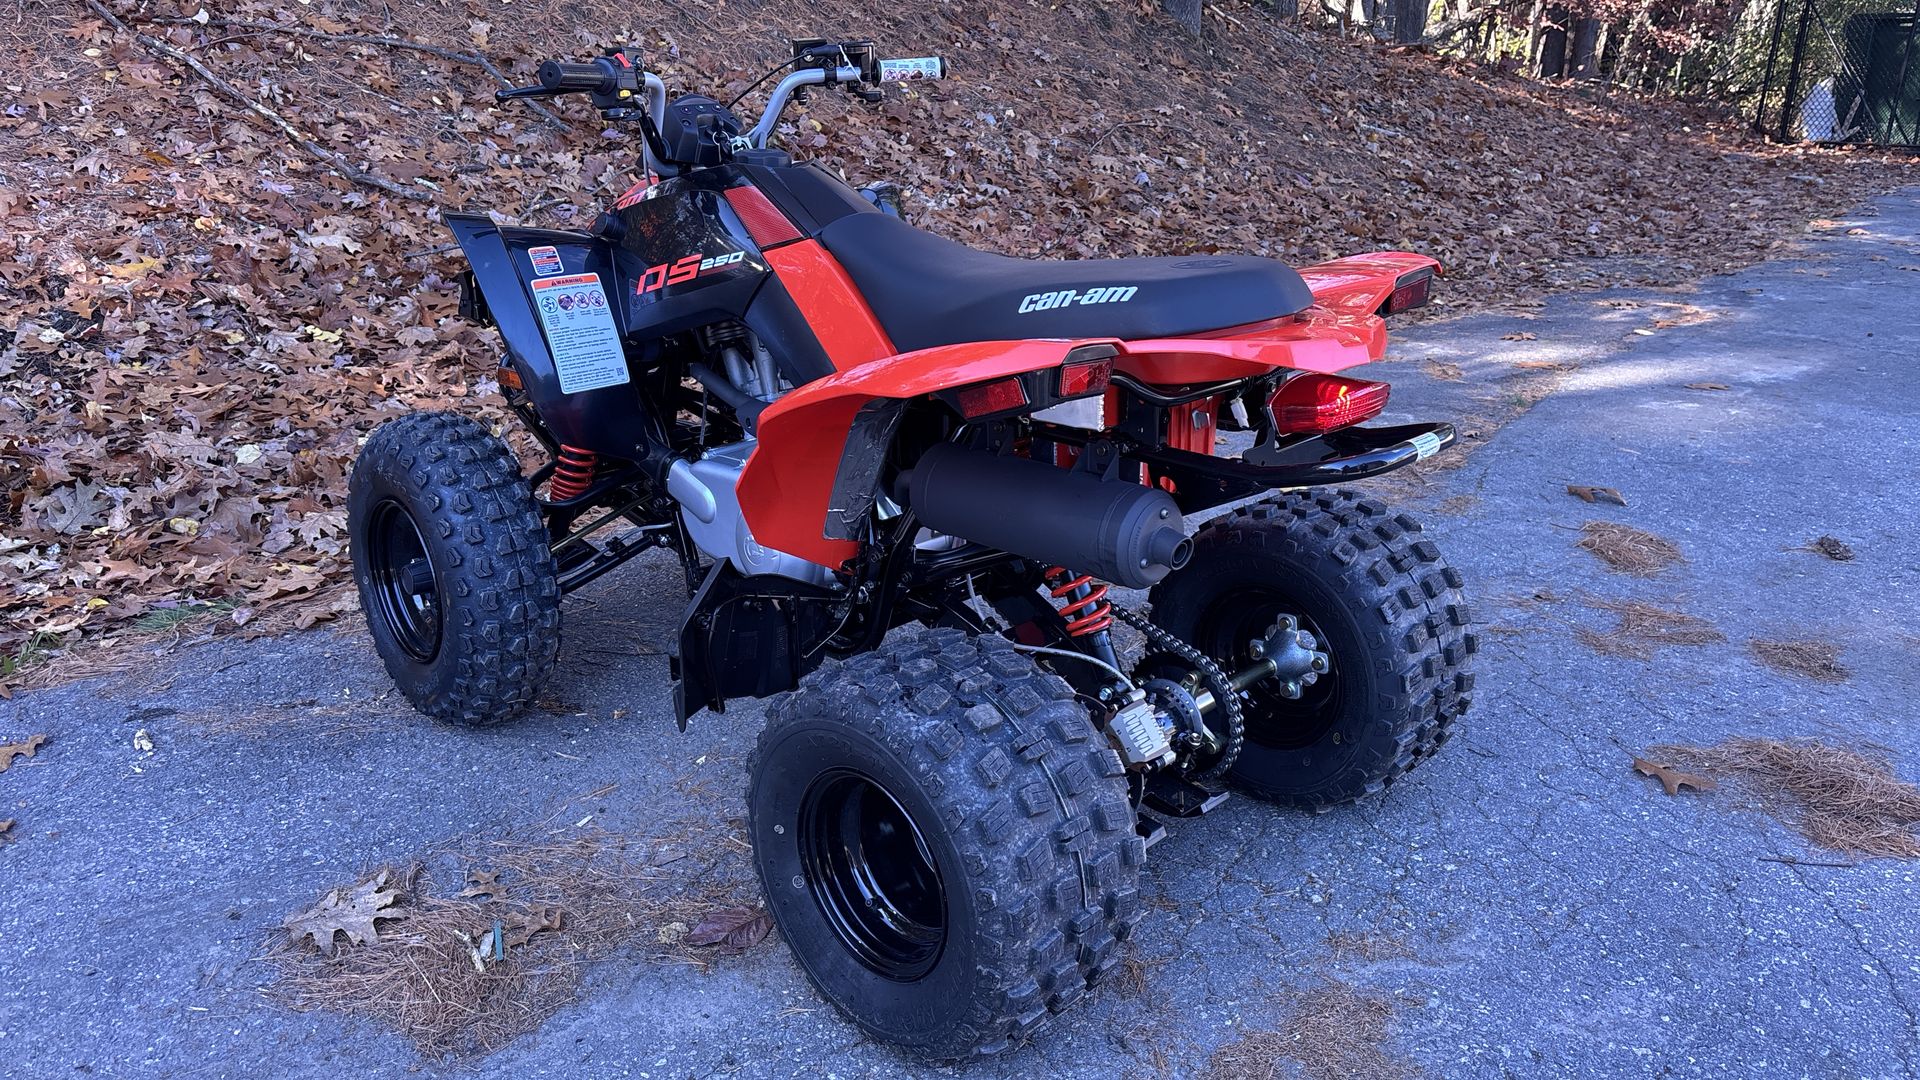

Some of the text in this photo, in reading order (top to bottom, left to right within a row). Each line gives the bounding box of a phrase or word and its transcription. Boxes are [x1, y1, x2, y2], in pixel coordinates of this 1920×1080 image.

[558, 277, 583, 286] WARNING
[636, 251, 745, 295] DS 250
[1018, 285, 1139, 314] can-am
